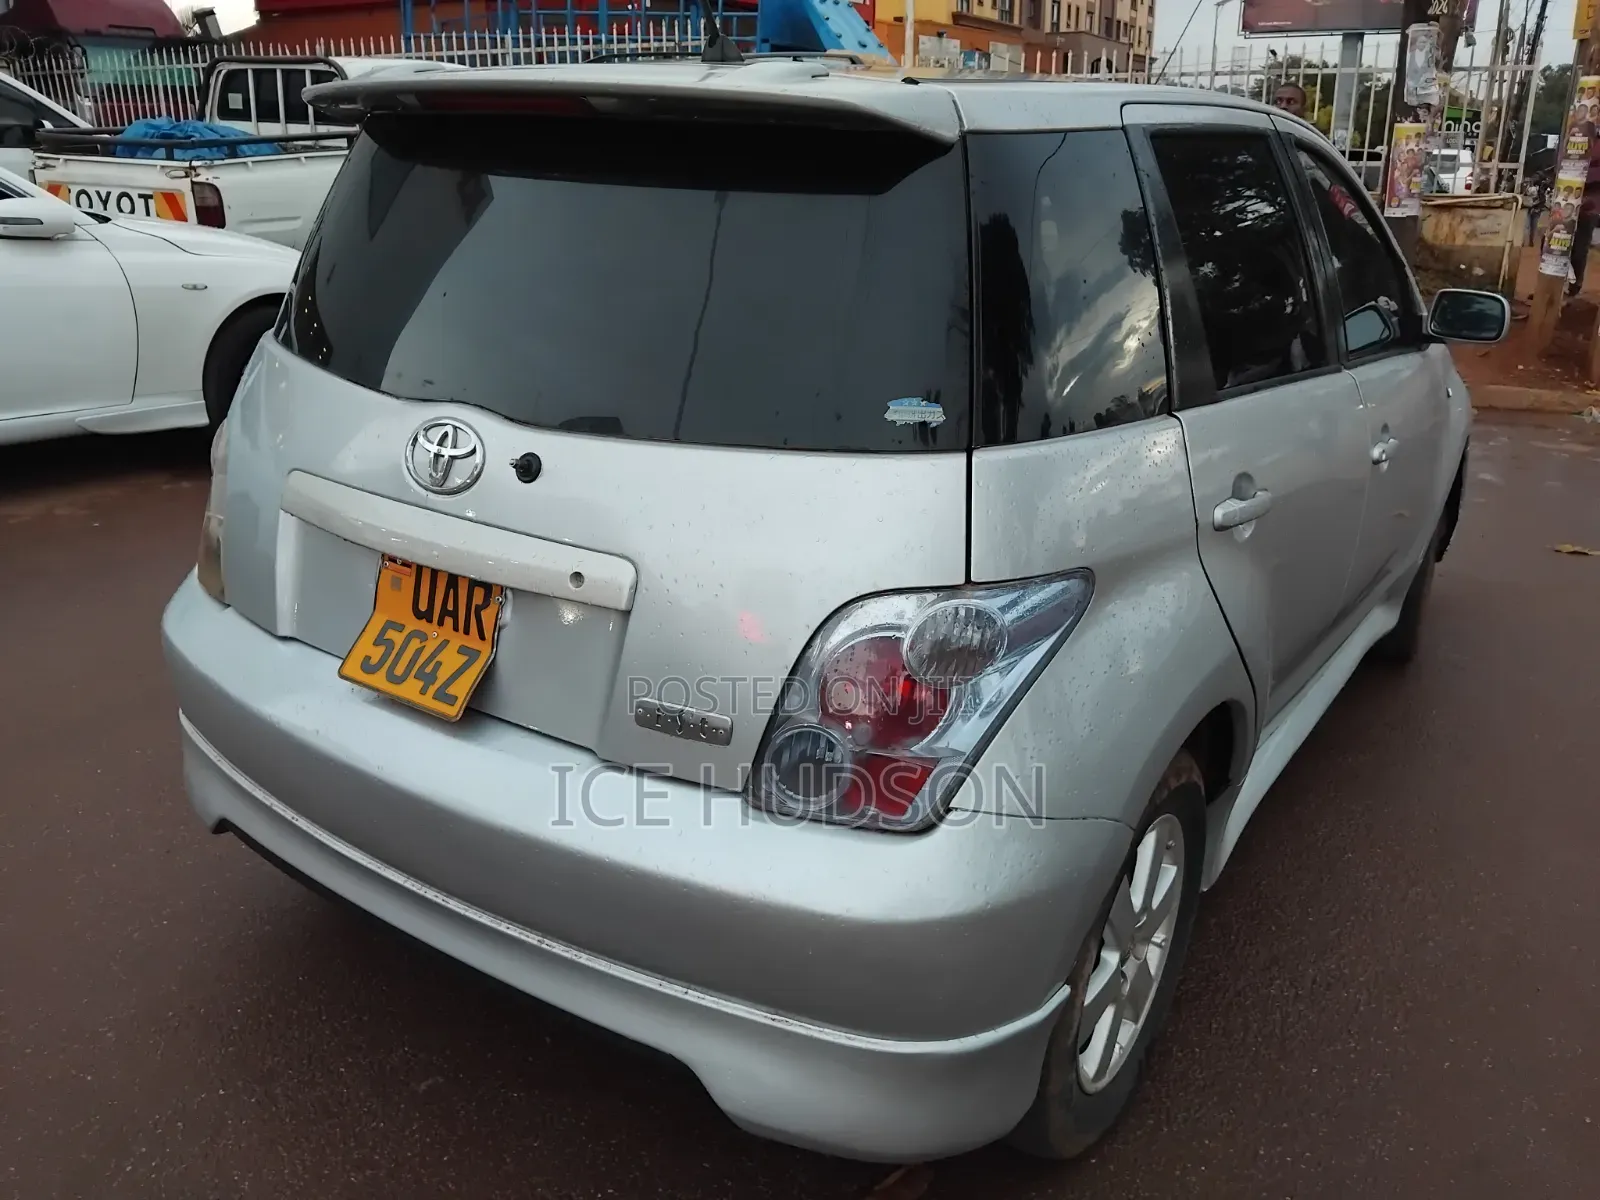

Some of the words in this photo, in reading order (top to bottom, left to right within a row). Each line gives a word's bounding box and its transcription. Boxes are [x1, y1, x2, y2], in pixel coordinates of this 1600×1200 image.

[67, 187, 154, 217] OYOT
[411, 562, 494, 642] UAR
[360, 619, 482, 707] 504Z
